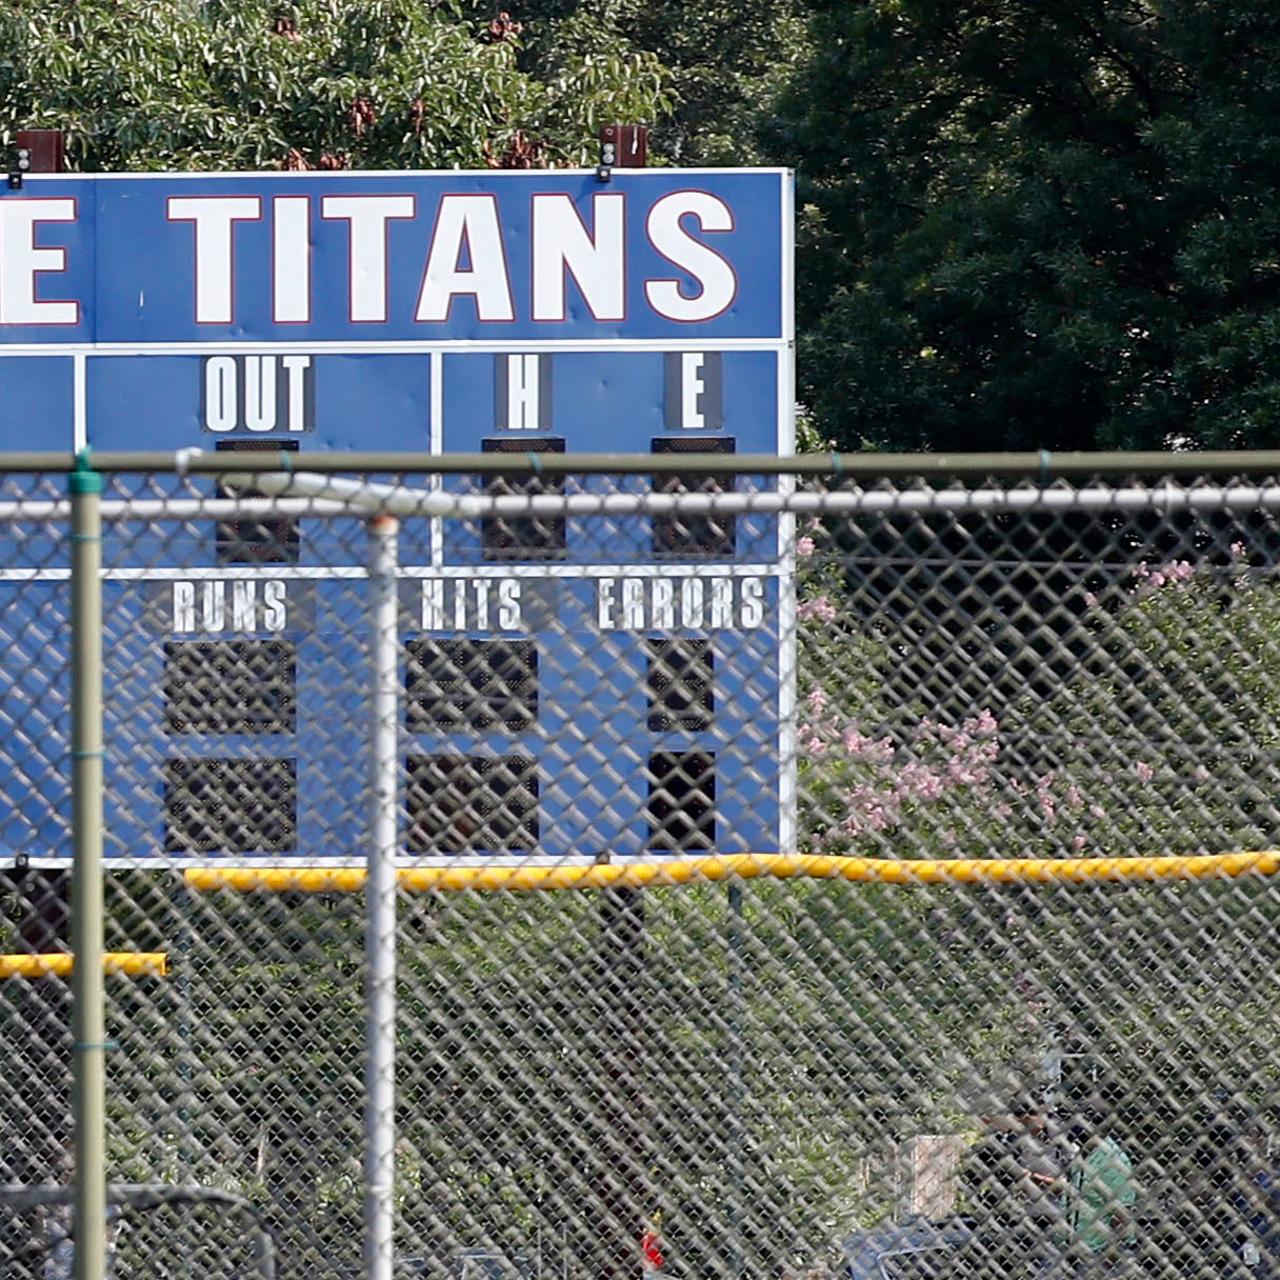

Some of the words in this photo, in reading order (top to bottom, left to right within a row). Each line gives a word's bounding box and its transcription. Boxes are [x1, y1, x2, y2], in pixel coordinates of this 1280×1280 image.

[166, 189, 738, 323] TITANS
[205, 355, 310, 432] OUT
[508, 355, 539, 429] H
[682, 353, 705, 428] E
[174, 581, 286, 632] RUNS
[421, 579, 521, 631] HITS
[598, 577, 765, 629] ERRORS
